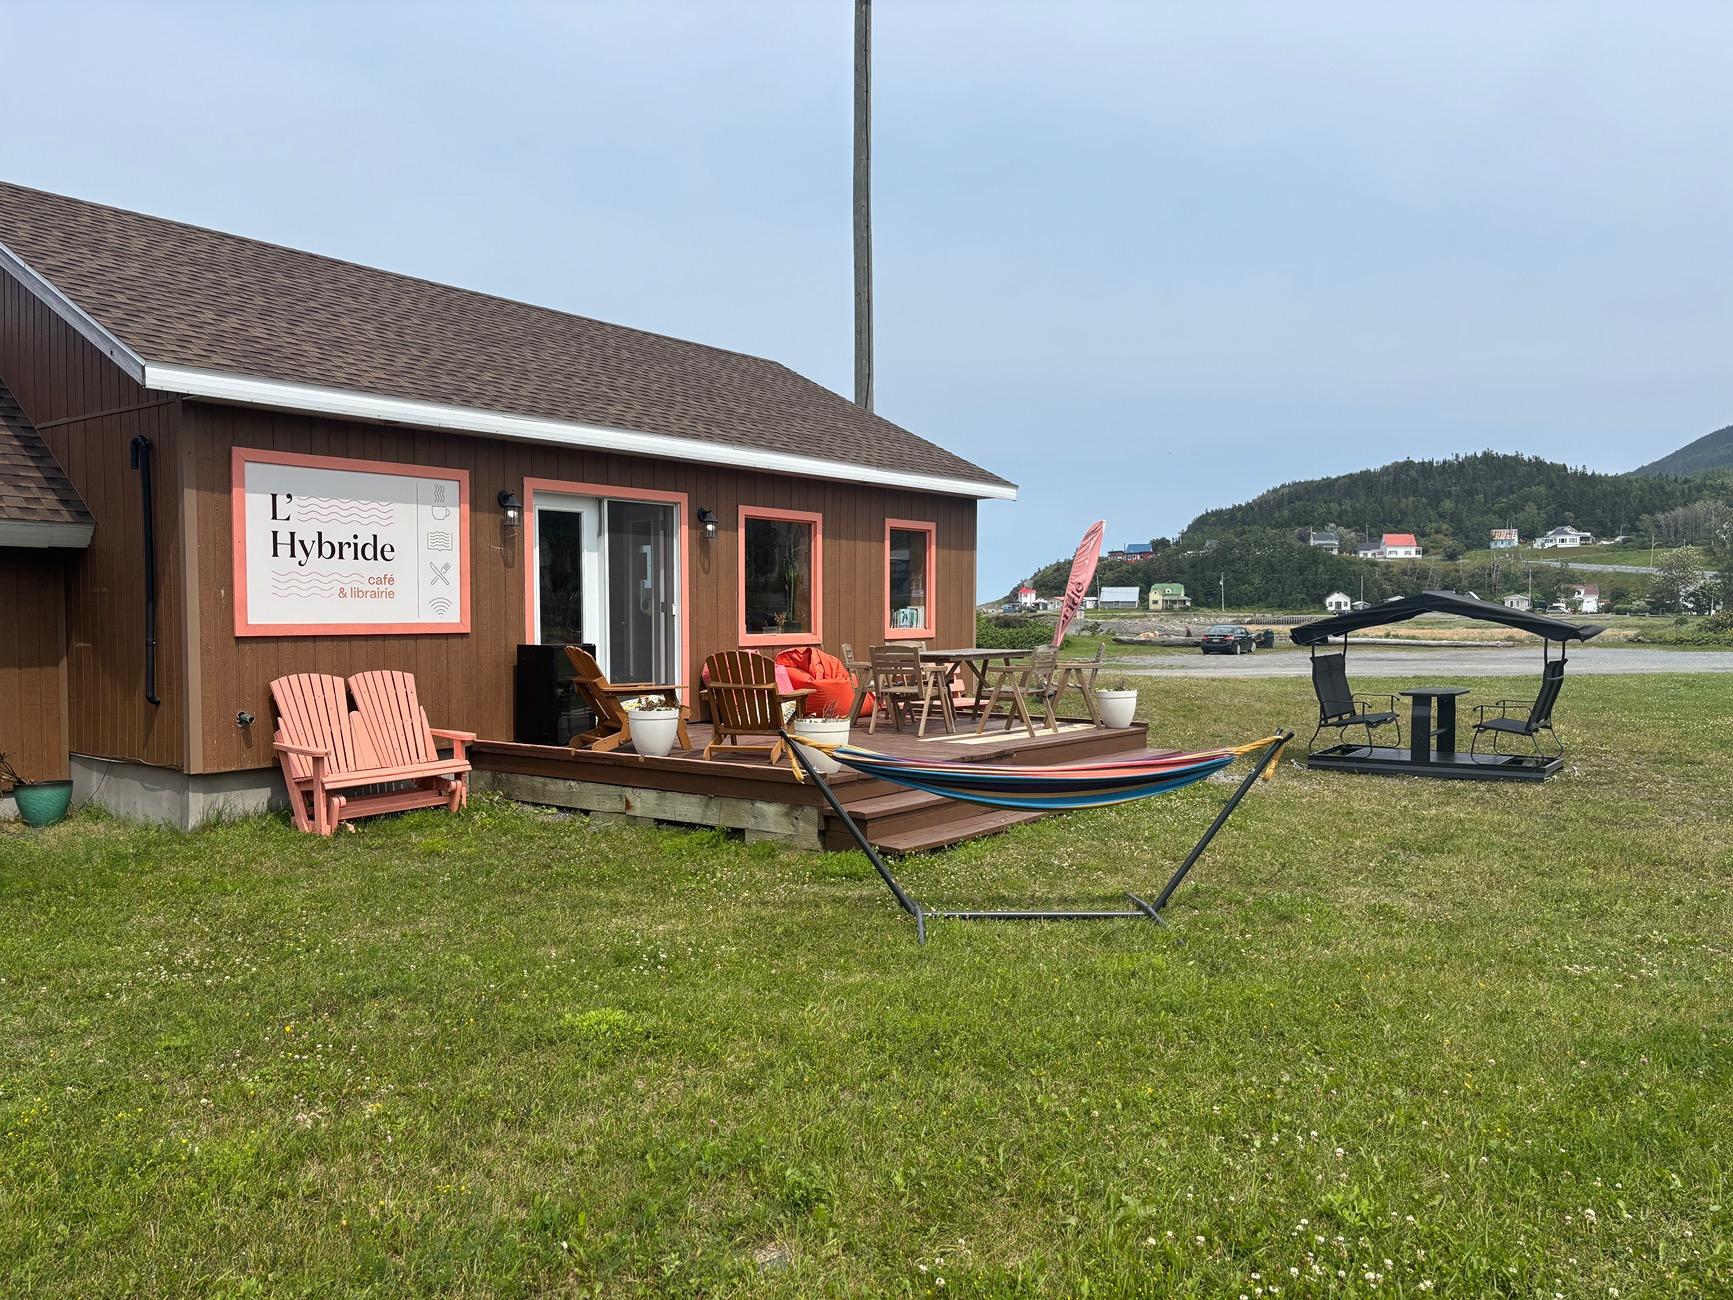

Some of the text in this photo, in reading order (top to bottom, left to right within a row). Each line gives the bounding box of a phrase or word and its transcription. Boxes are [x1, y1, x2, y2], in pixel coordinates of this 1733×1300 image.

[271, 530, 396, 567] Hybride
[367, 573, 396, 586] café
[337, 586, 396, 600] & librairie
